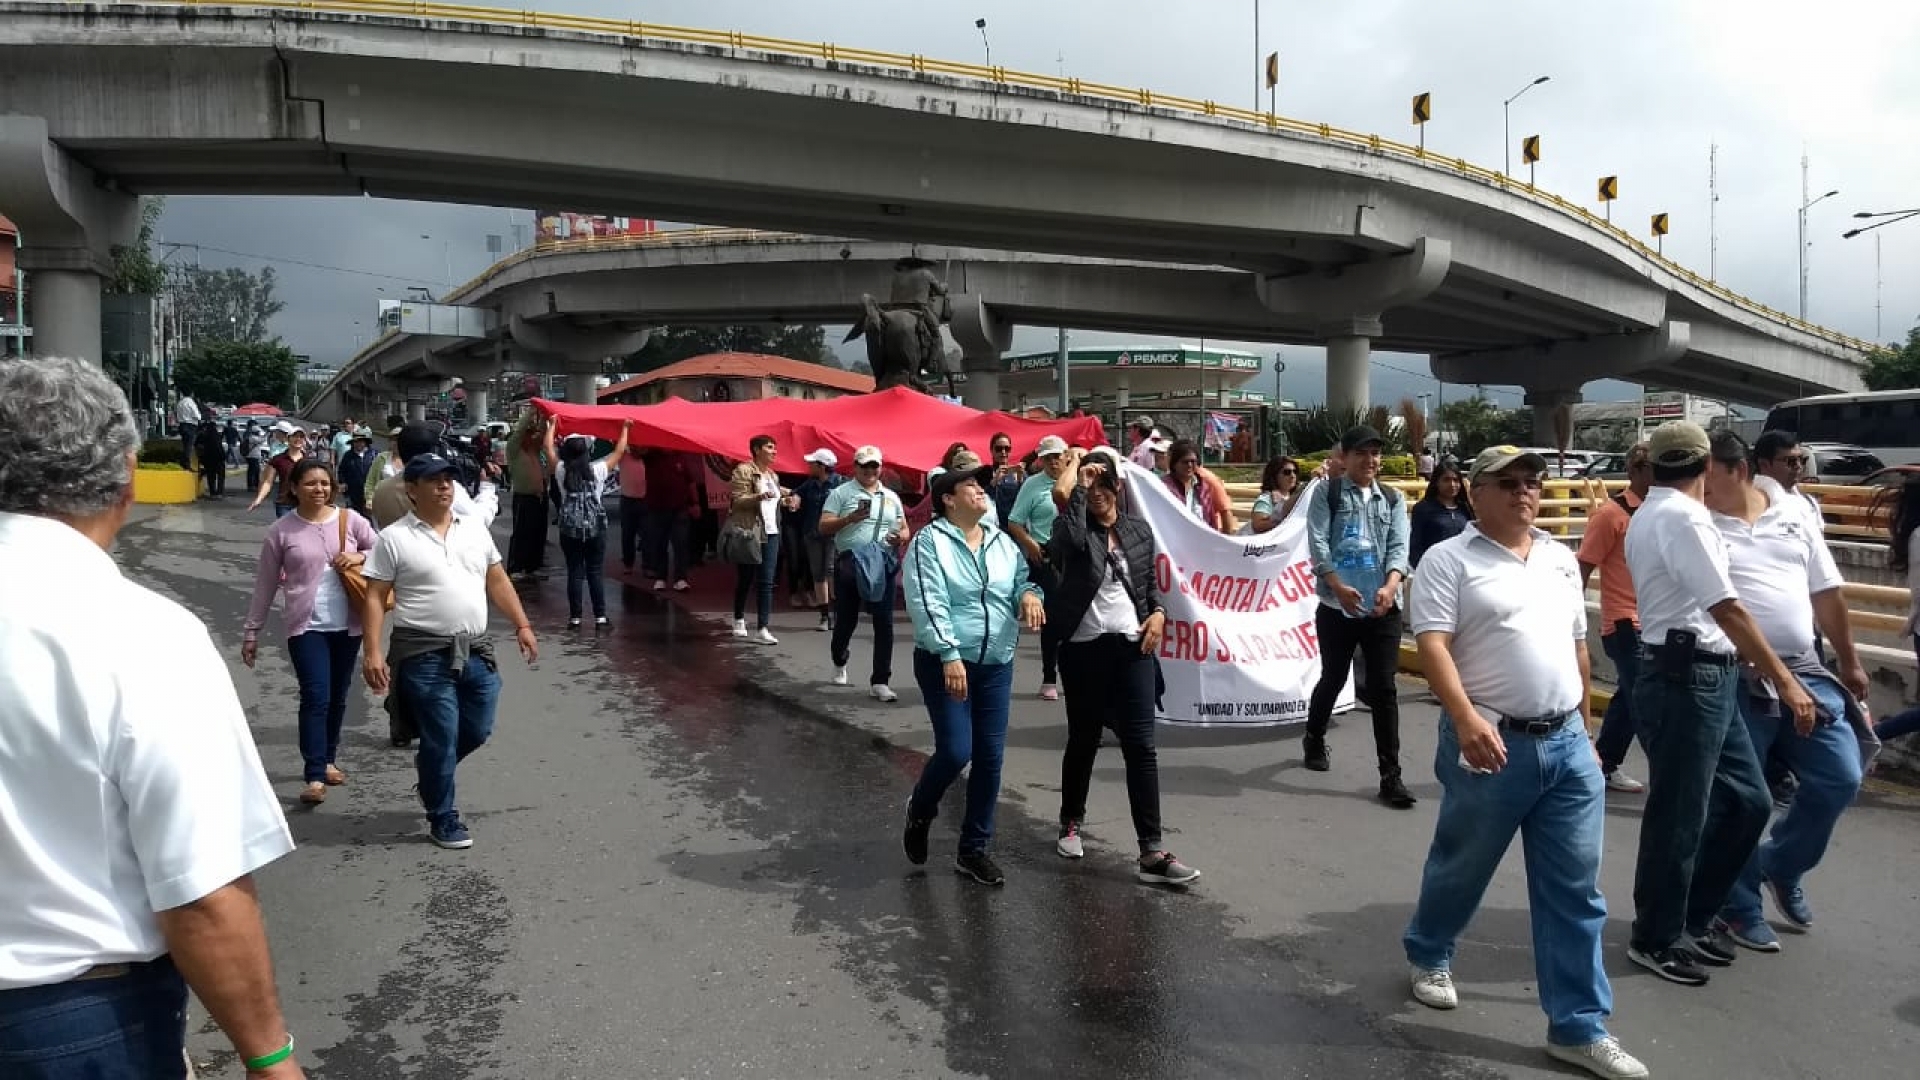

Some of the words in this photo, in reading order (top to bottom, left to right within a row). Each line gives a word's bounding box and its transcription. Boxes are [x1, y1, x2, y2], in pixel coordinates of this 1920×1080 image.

[1133, 353, 1179, 365] PEMEX
[1231, 358, 1258, 369] PEMEX
[1160, 619, 1208, 662] ERO
[1236, 702, 1243, 716] Y
